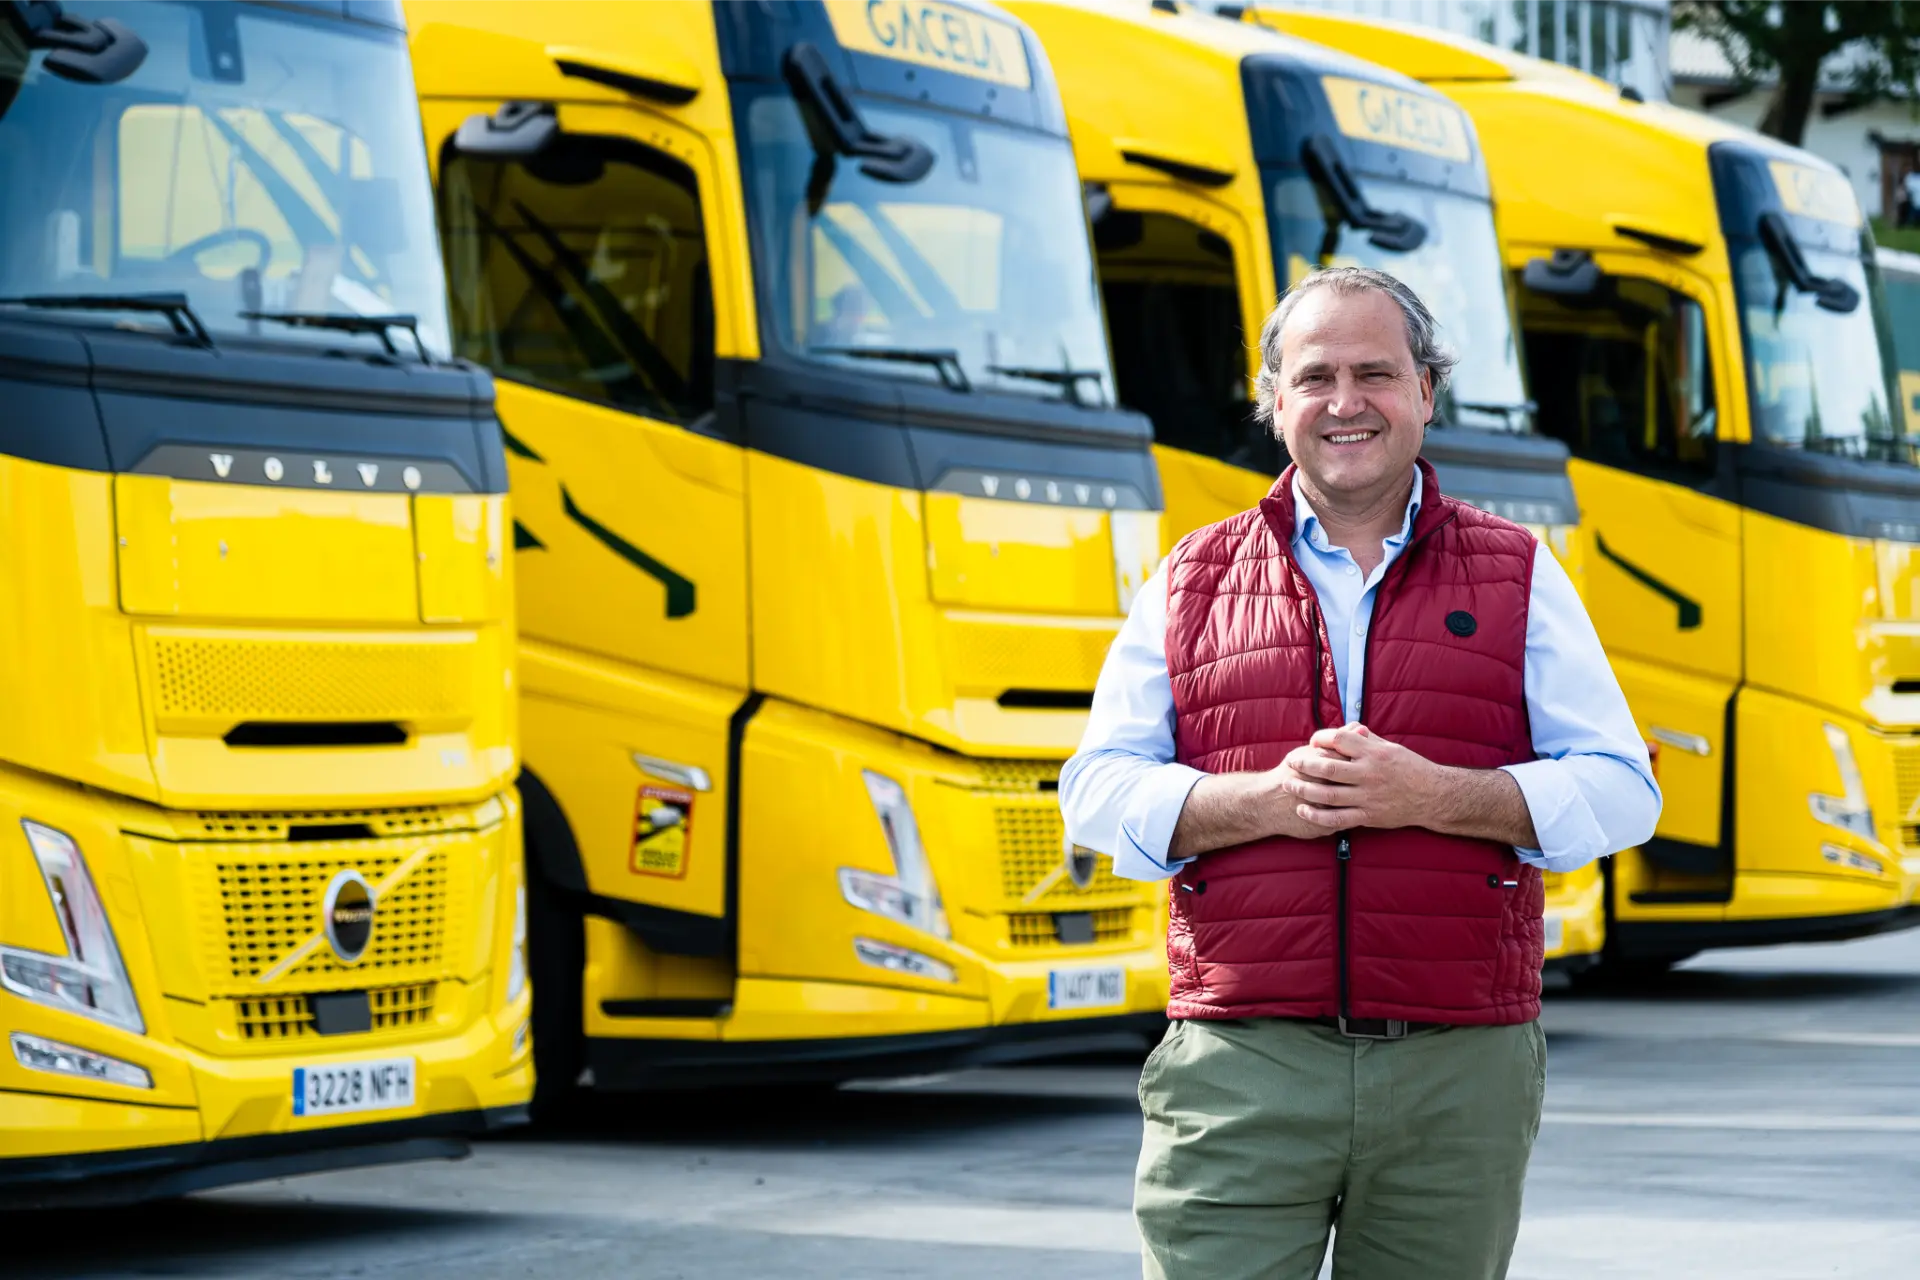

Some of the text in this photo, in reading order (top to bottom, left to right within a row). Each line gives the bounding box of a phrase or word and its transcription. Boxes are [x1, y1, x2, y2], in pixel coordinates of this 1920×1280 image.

[866, 0, 1006, 75] GACELA
[208, 453, 422, 490] VOLVO
[981, 475, 1117, 508] VOLVO
[309, 1064, 410, 1107] 3228 NFH
